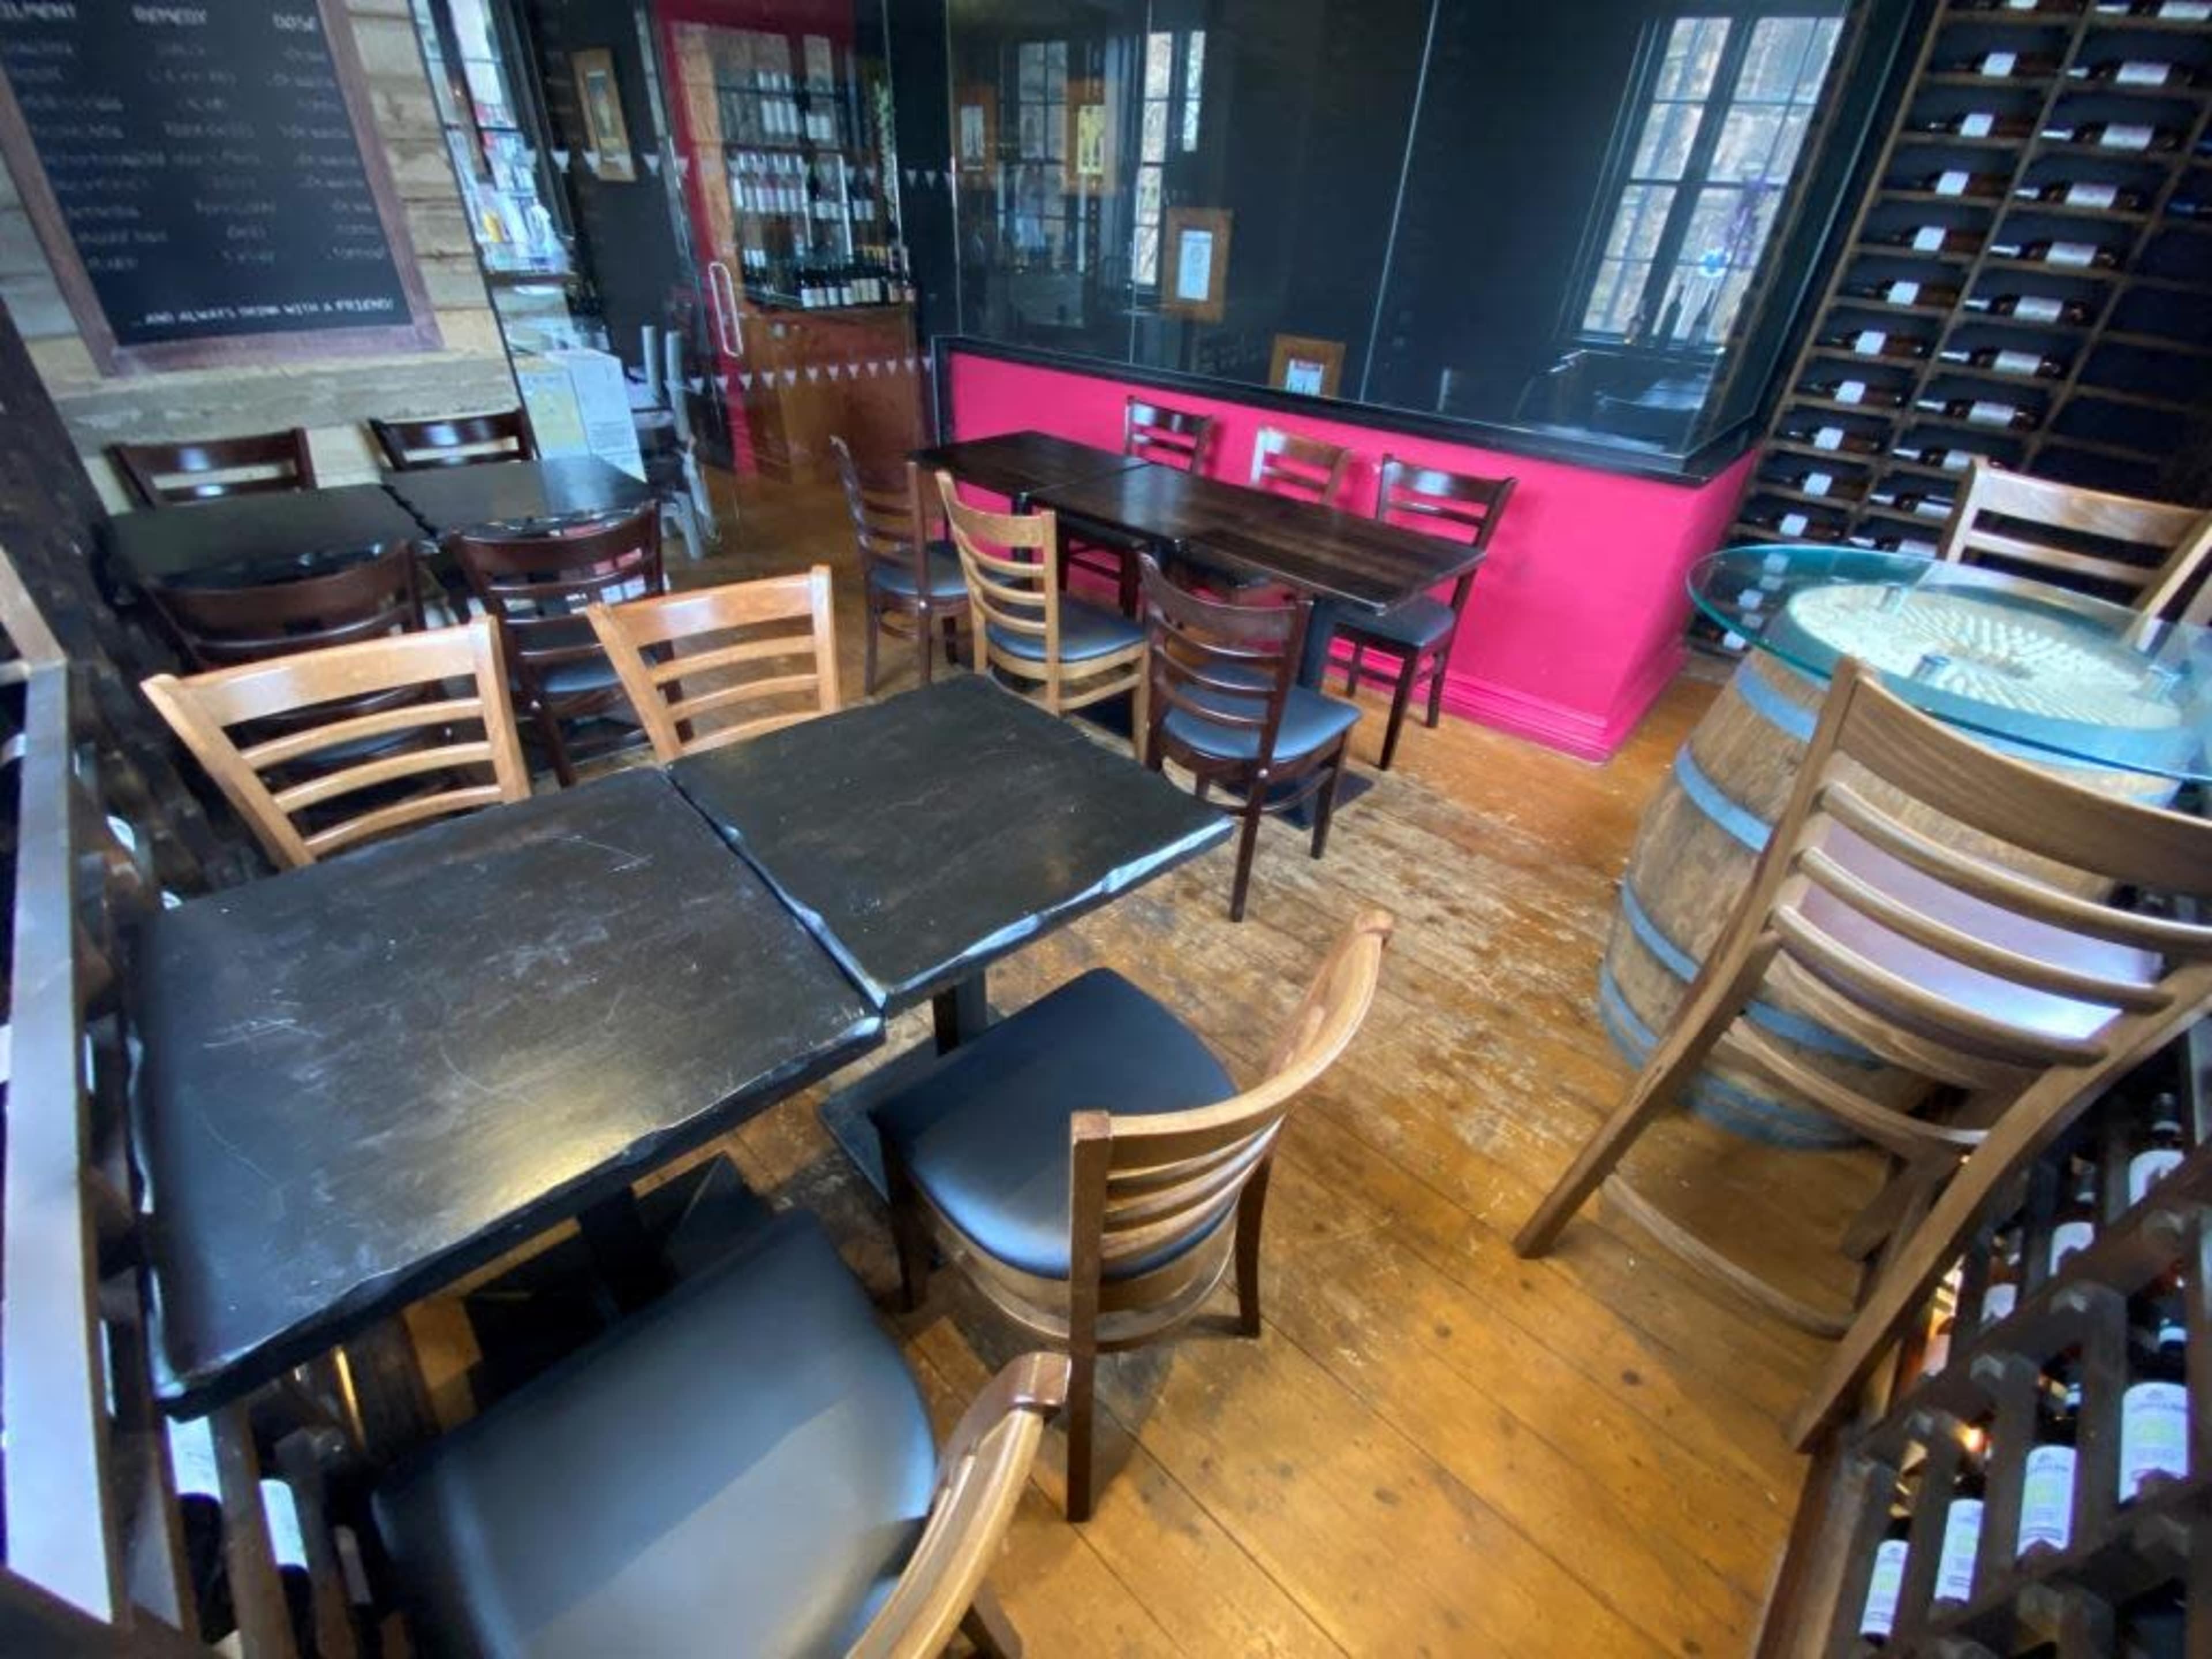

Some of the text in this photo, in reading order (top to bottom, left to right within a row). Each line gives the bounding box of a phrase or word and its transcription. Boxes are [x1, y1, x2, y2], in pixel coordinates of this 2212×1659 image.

[0, 2, 76, 19] ILMENT
[178, 308, 236, 323] ALWAYS
[282, 302, 319, 316] WITH
[323, 302, 333, 312] A
